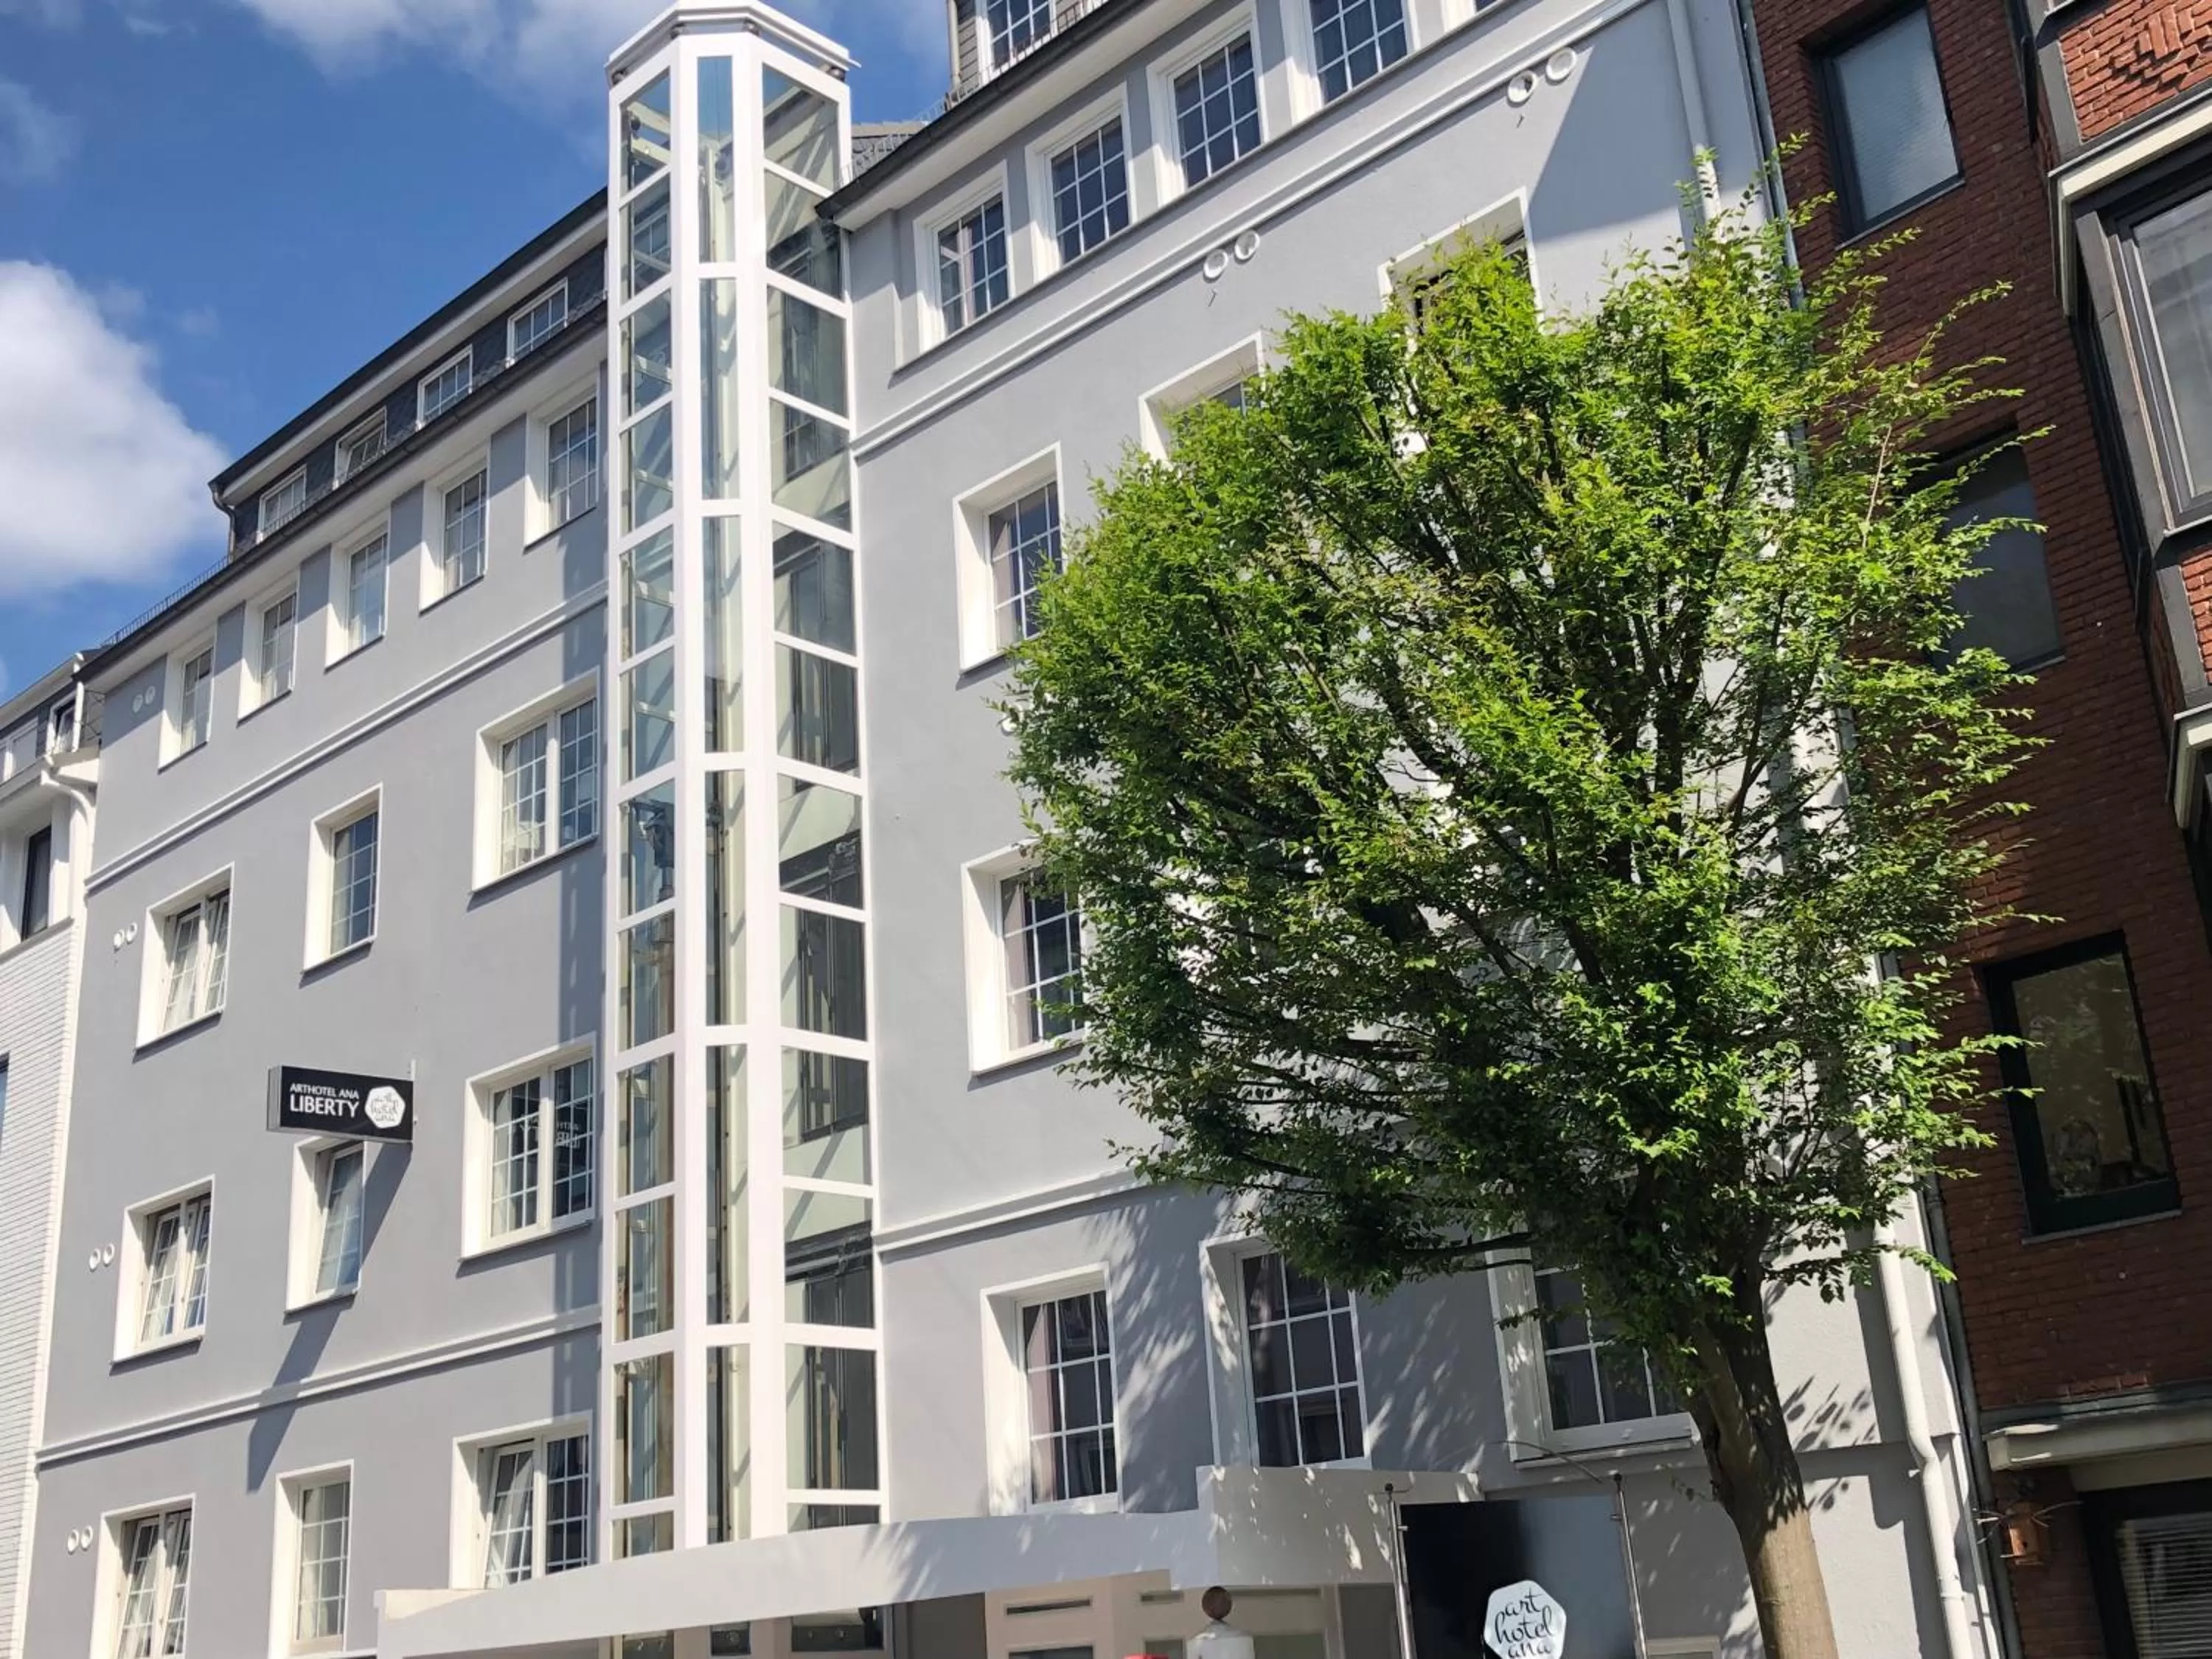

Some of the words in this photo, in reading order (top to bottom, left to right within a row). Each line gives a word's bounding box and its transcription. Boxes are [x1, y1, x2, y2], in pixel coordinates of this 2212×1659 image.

[290, 1083, 336, 1096] ARTHOTEL
[338, 1089, 360, 1099] ANA
[290, 1094, 359, 1118] LIBERTY
[1505, 1587, 1543, 1616] art
[1495, 1606, 1554, 1644] hotel
[1508, 1643, 1551, 1658] ana
